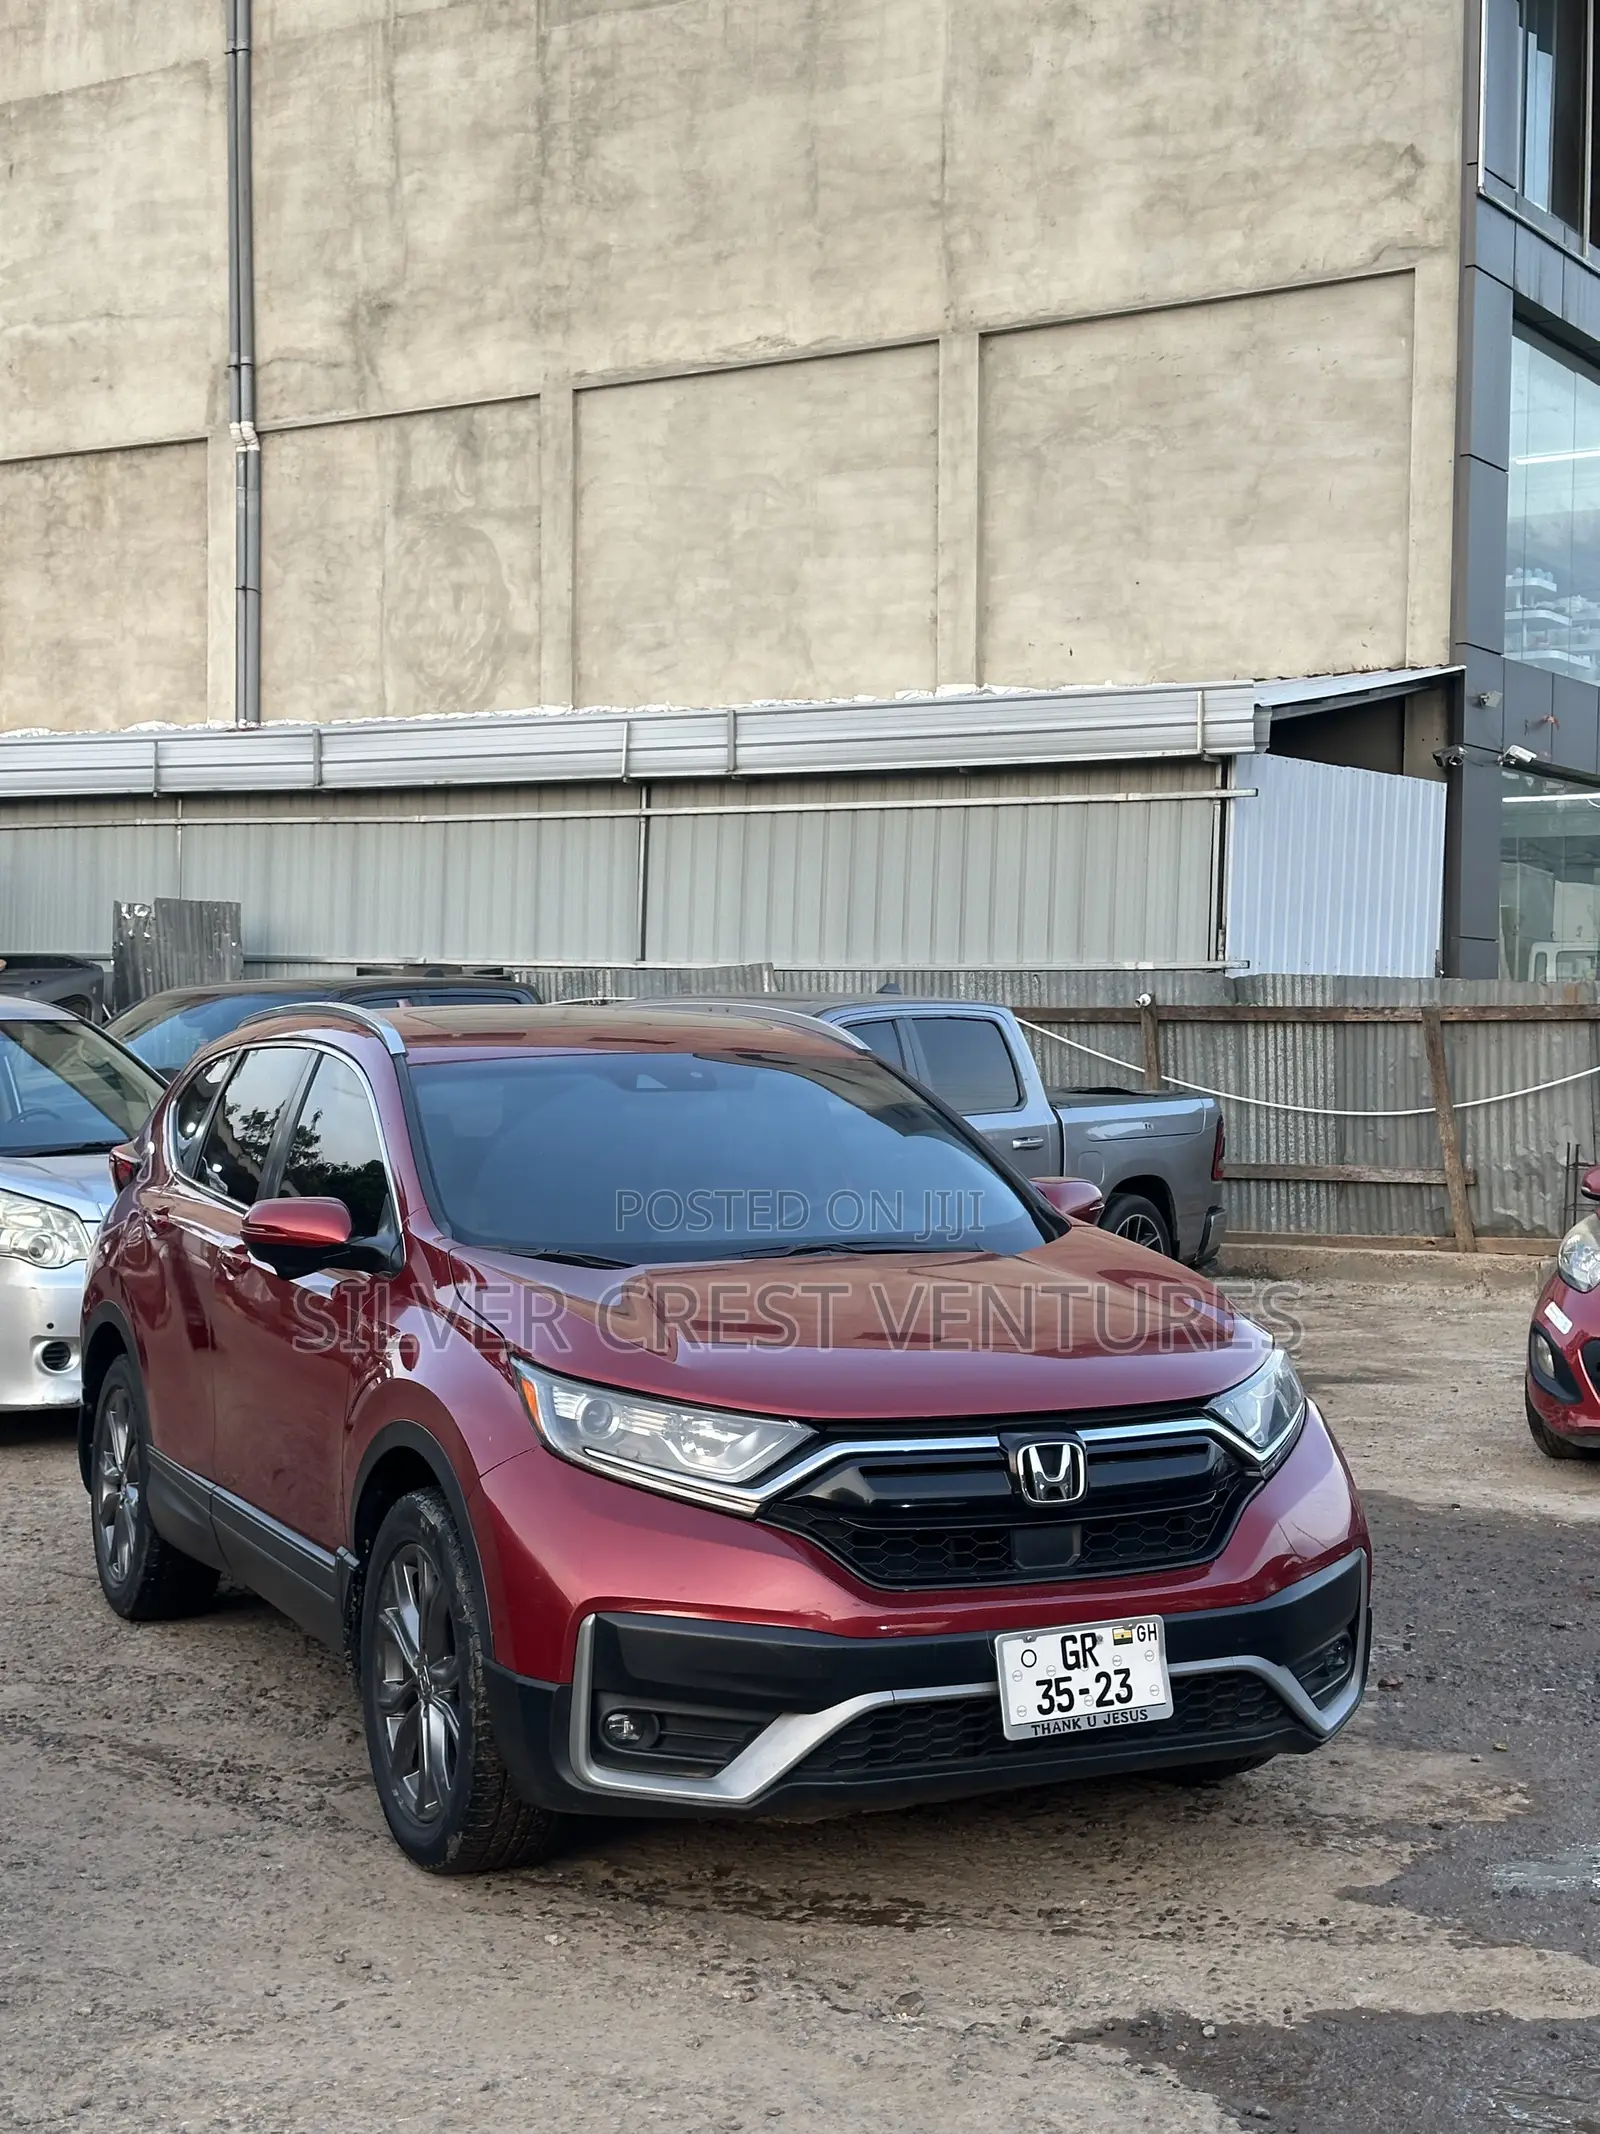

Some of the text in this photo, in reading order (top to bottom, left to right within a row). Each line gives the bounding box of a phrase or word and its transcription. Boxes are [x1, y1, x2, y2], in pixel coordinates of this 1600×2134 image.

[1136, 1623, 1158, 1643] GH
[1060, 1632, 1100, 1670] GR
[1036, 1668, 1133, 1715] 35-23
[1031, 1709, 1149, 1736] THANK U JESUS
